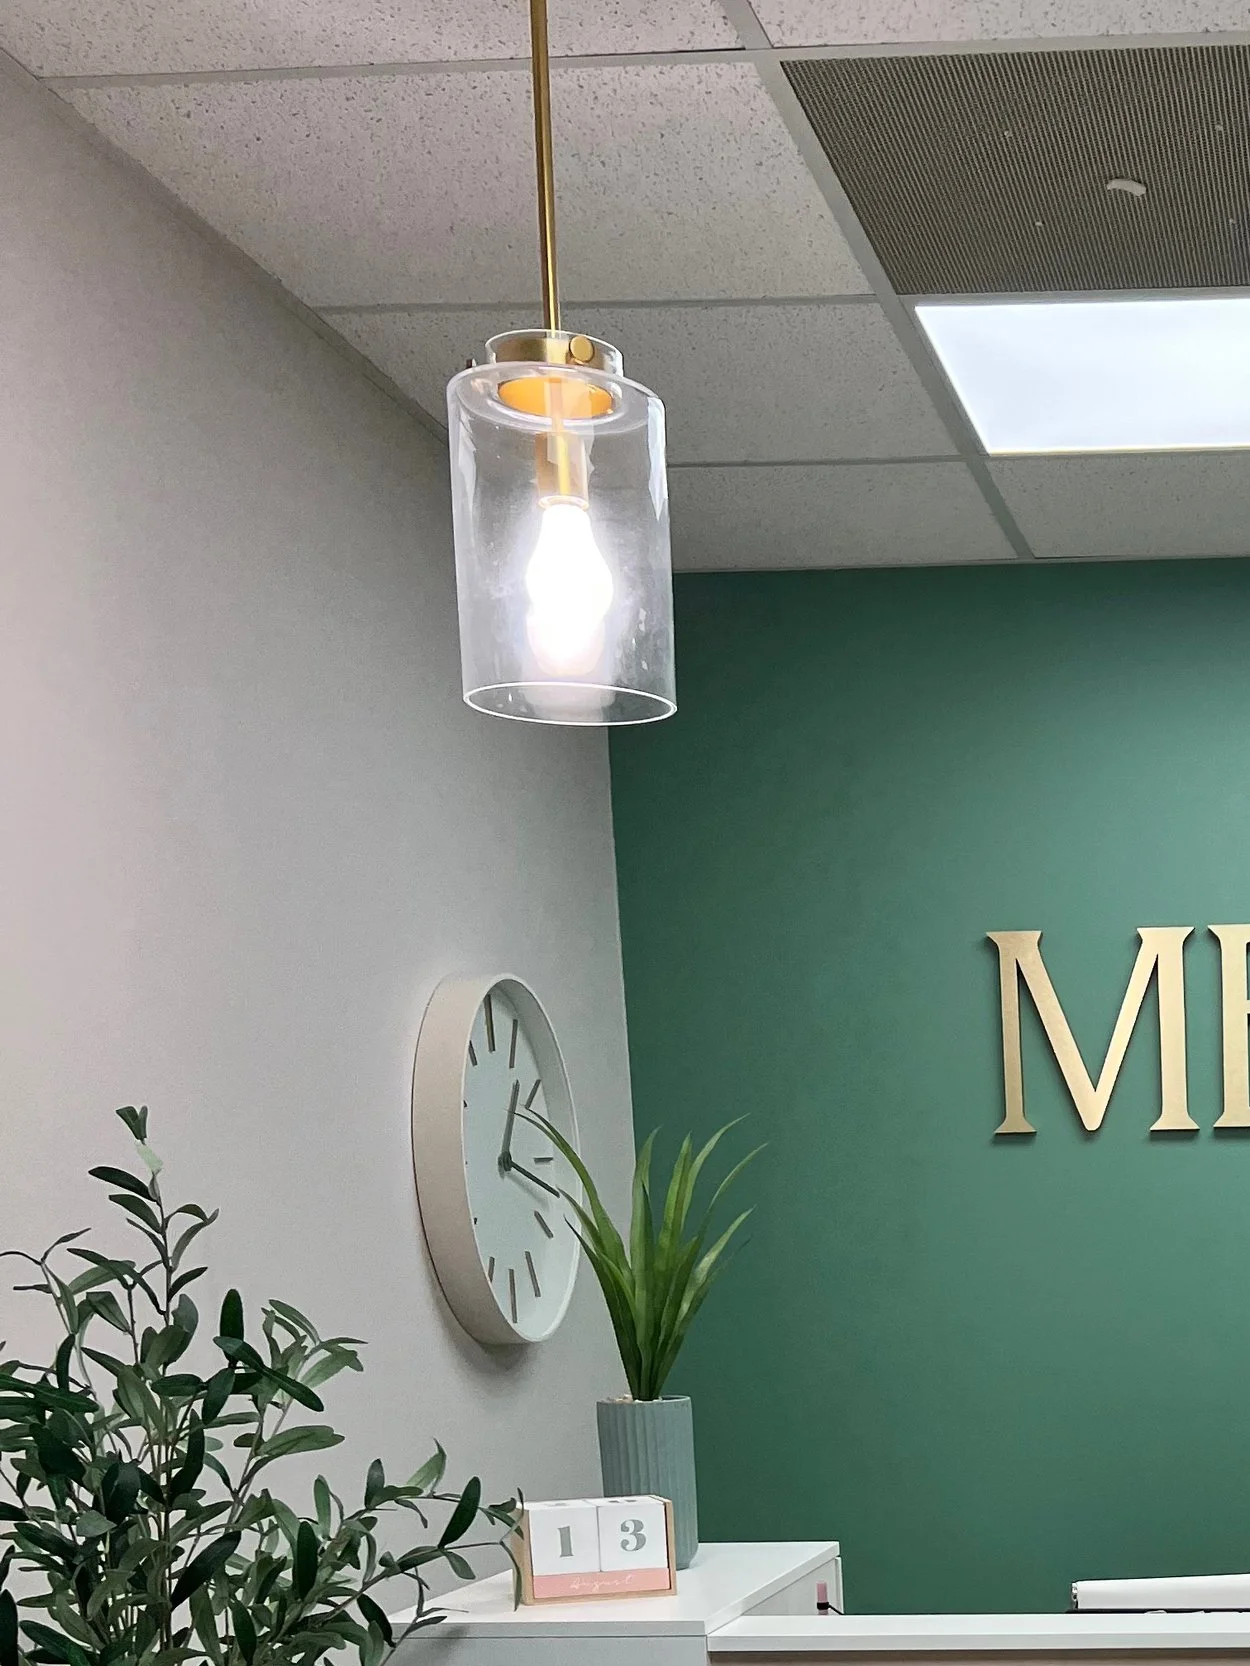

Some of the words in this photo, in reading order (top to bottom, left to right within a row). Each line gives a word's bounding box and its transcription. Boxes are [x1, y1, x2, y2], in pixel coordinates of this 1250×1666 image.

[558, 1525, 573, 1558] 1
[620, 1519, 647, 1551] 3
[570, 1575, 634, 1593] August
